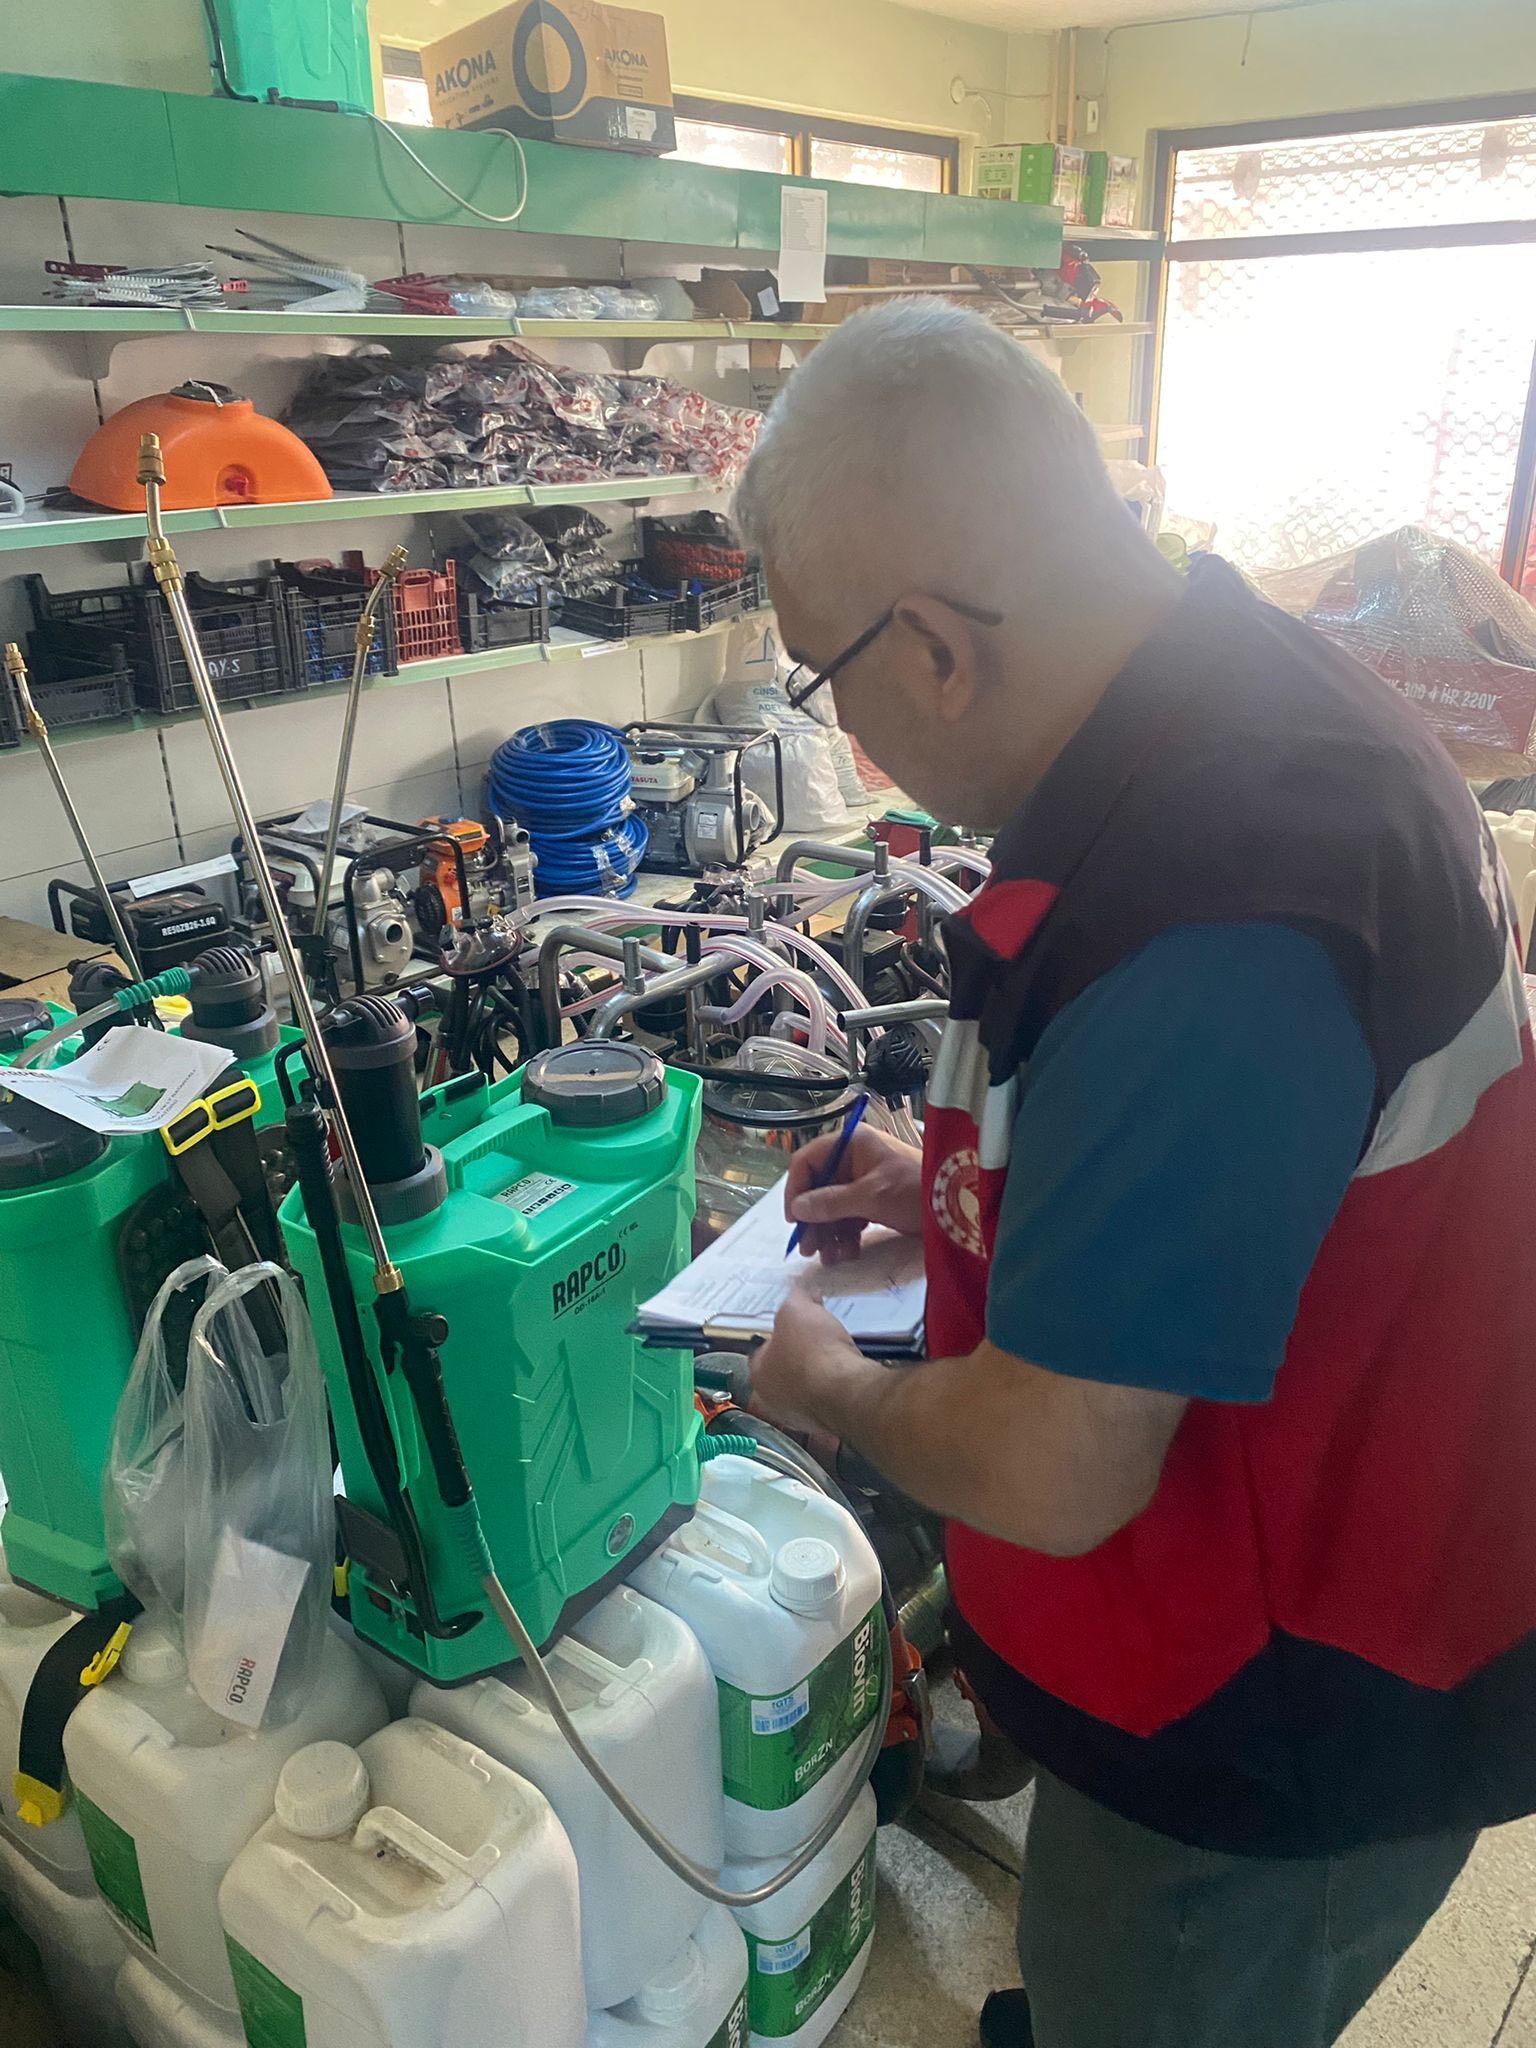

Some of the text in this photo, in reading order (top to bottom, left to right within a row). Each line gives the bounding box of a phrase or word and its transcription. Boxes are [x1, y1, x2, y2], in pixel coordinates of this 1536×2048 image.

[435, 49, 496, 96] AKONA
[604, 47, 648, 68] AKONA
[500, 1179, 531, 1198] RAPCO
[552, 1242, 620, 1315] RAPCO
[229, 1657, 257, 1705] RAPCO
